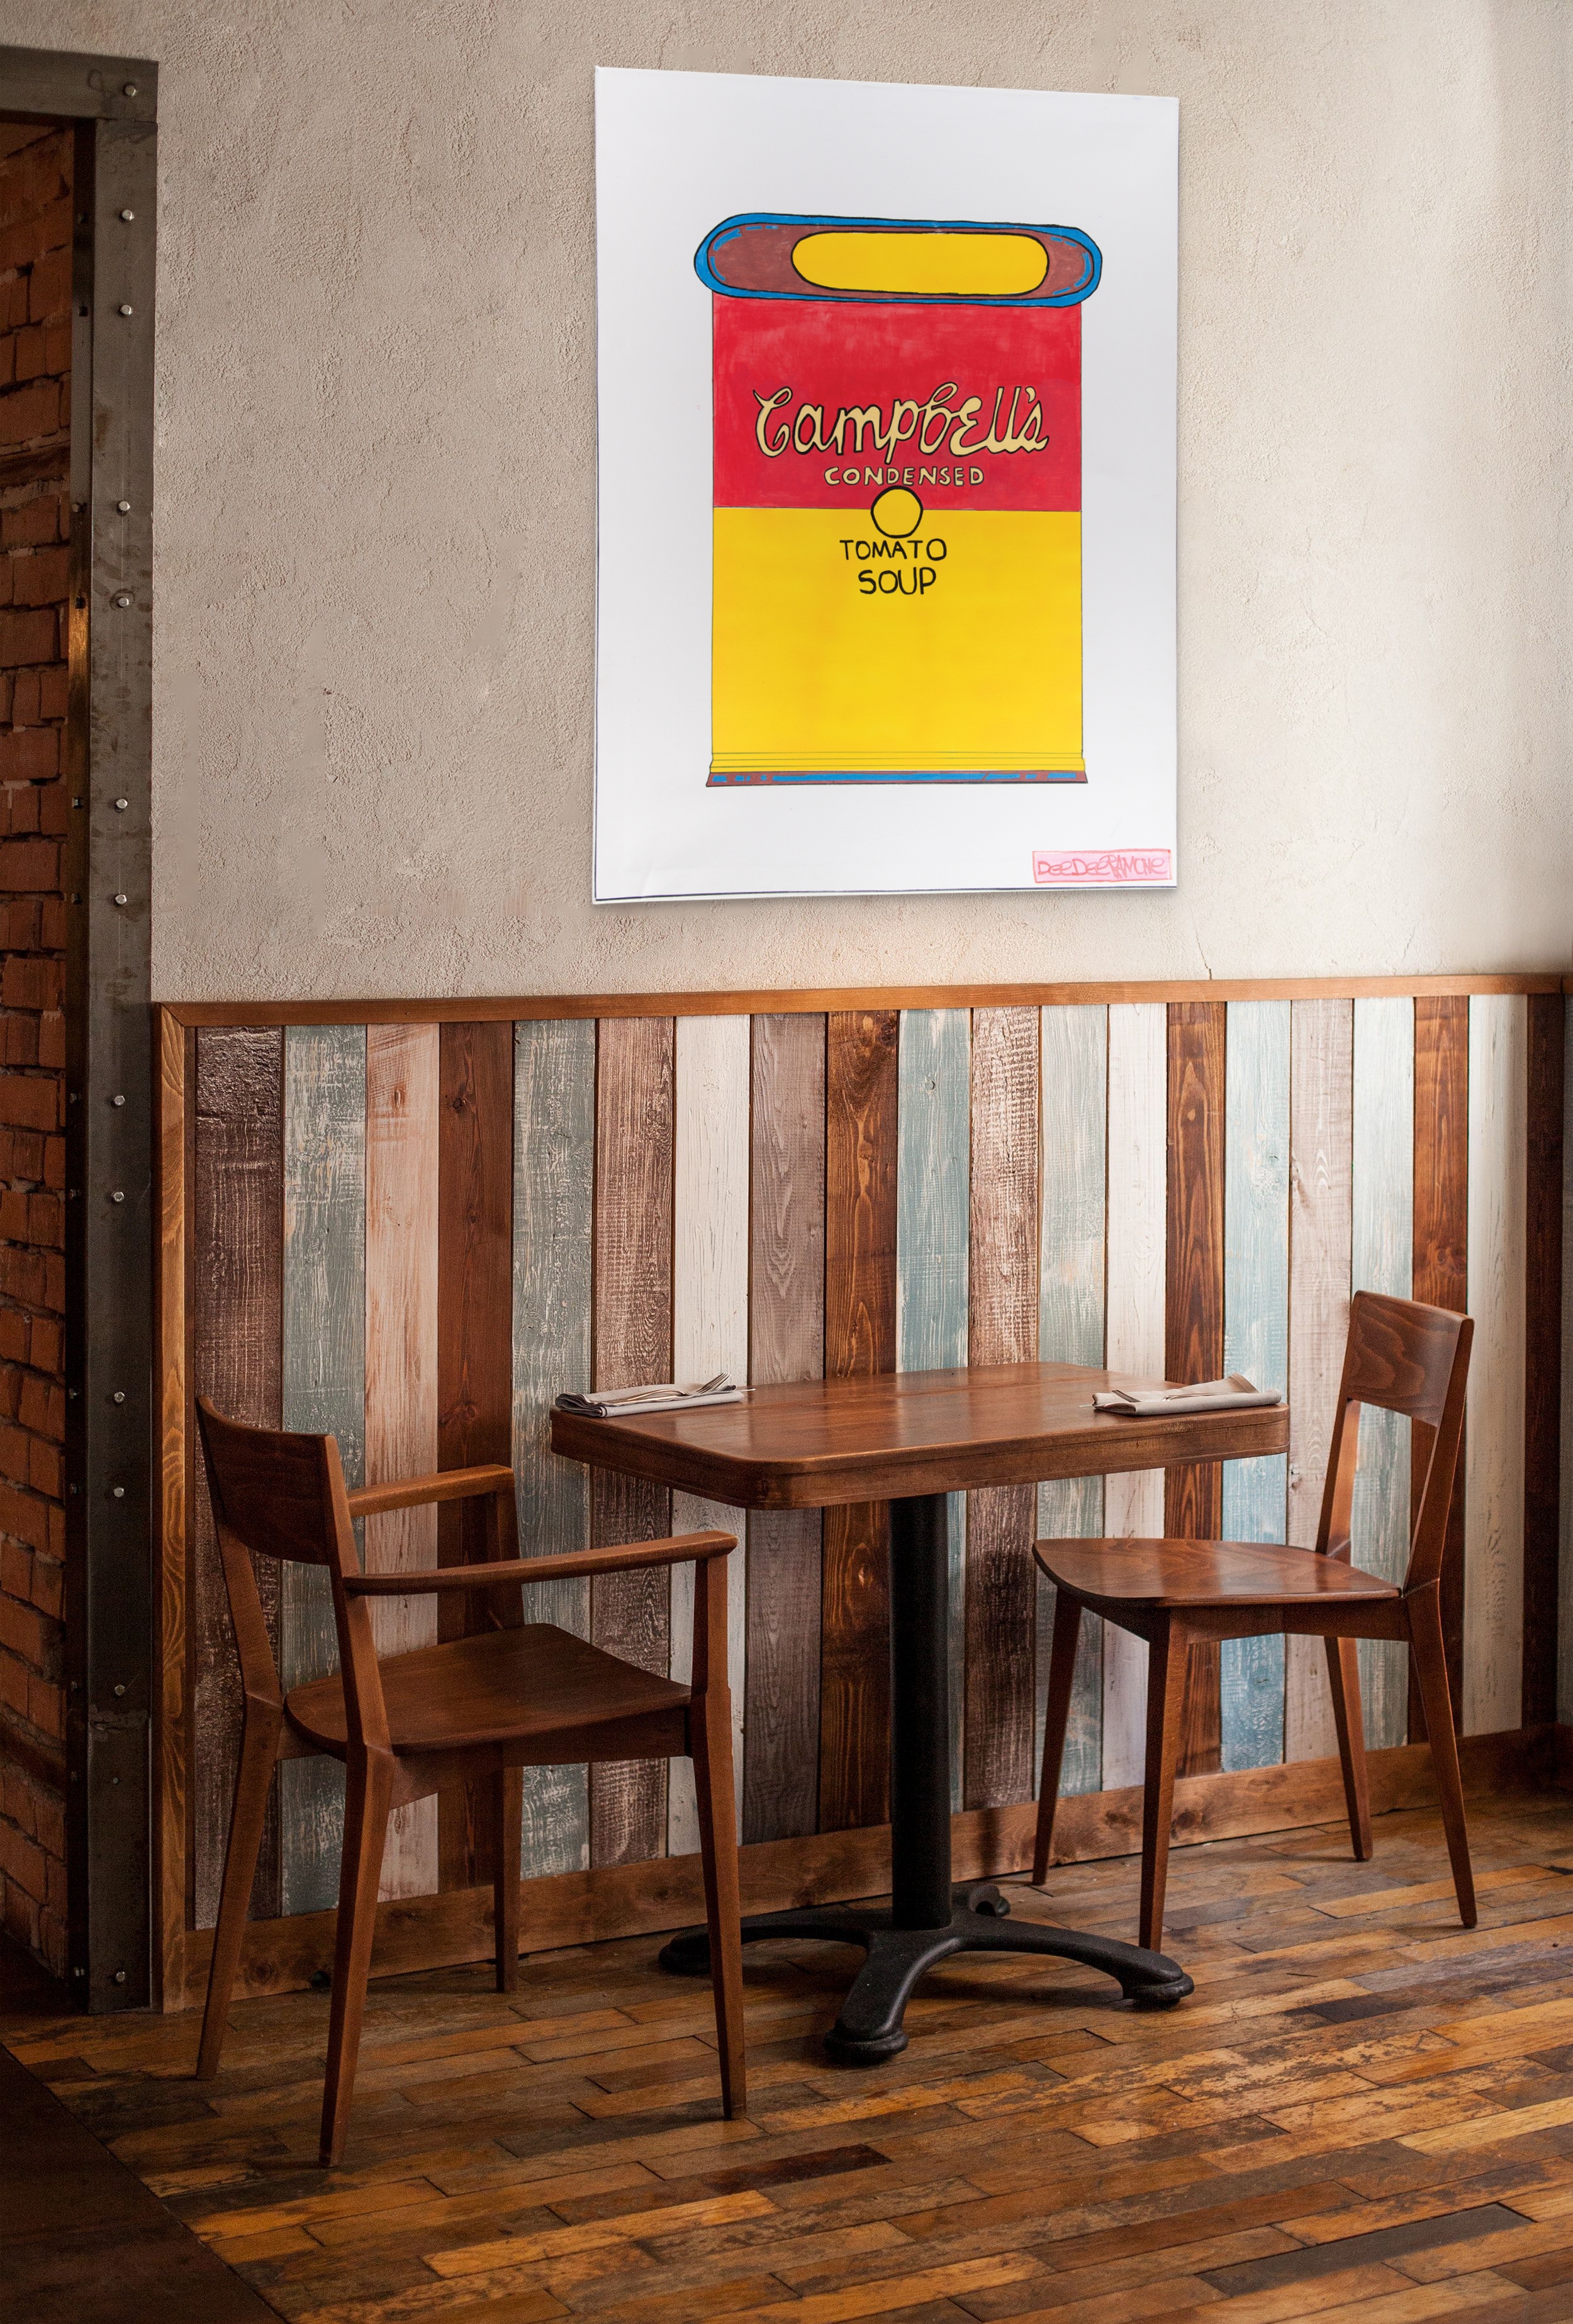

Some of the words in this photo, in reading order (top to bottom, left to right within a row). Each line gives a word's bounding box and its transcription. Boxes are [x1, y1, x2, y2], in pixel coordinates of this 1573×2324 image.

[824, 466, 985, 486] CONDENSED
[839, 539, 948, 561] TOMATO
[858, 567, 936, 594] SOUP
